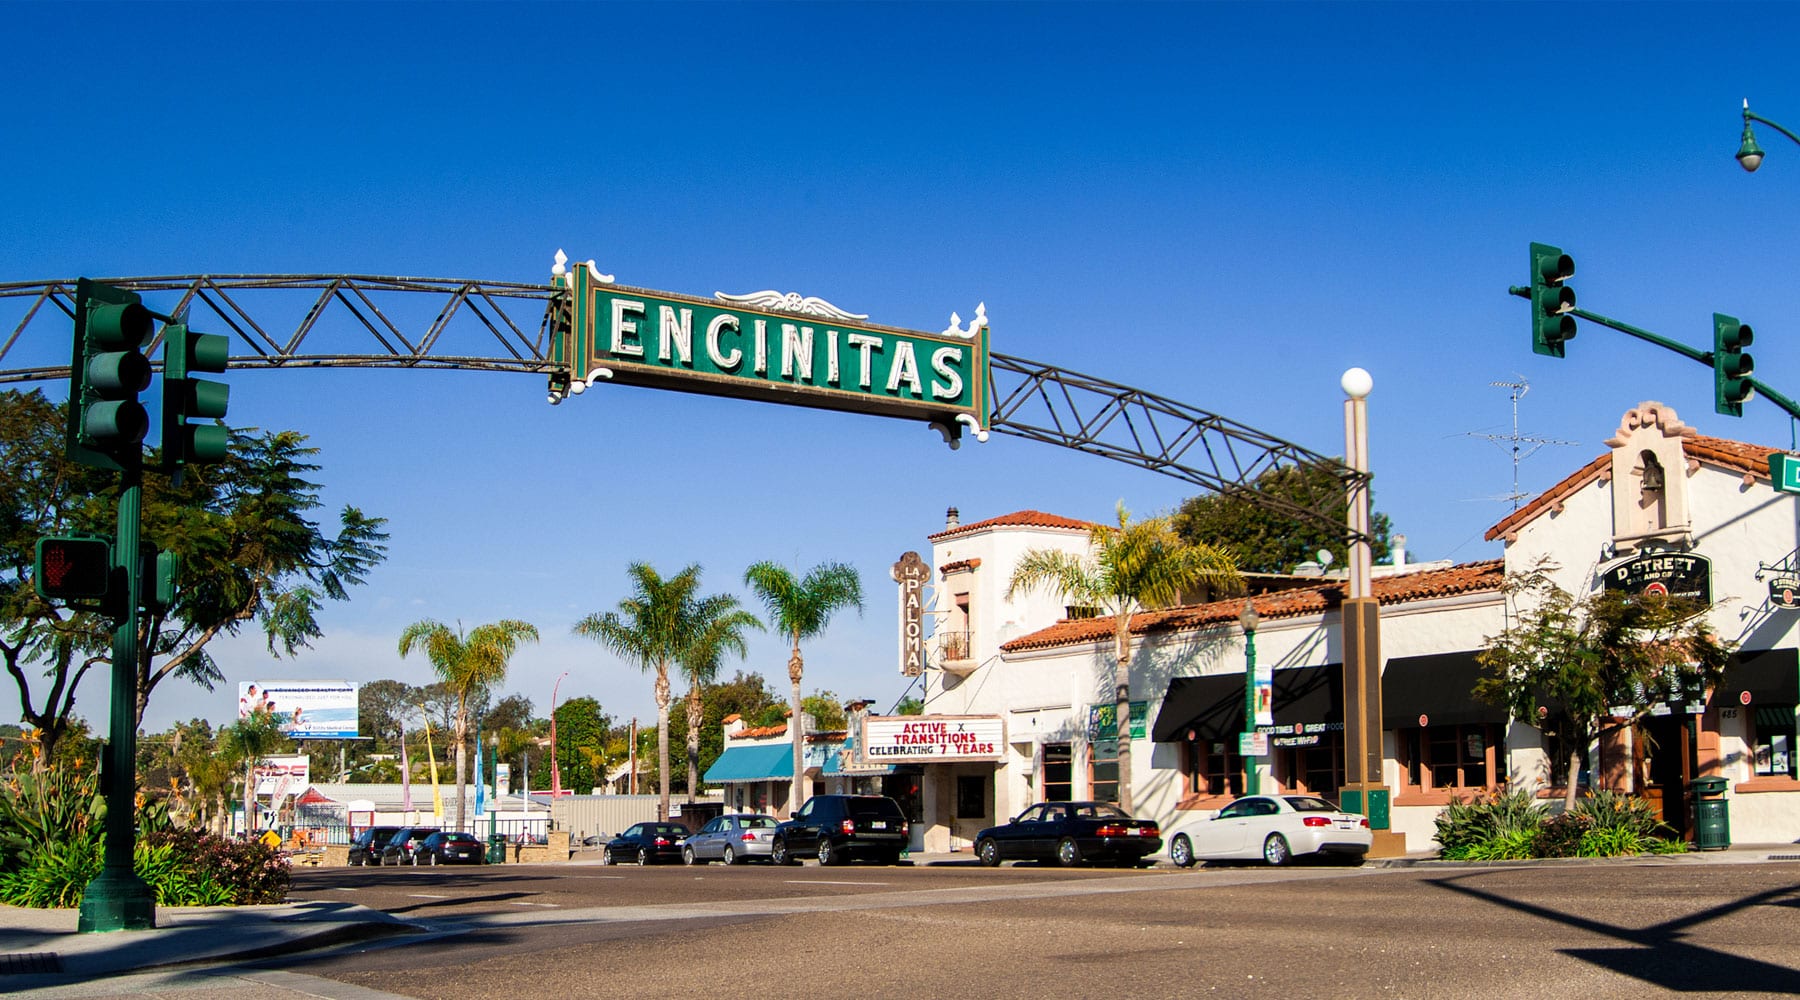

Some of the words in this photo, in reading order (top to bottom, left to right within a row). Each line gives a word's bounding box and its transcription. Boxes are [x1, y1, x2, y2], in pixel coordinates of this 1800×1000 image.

[609, 298, 964, 399] ENCINITAS
[905, 566, 920, 576] LA
[1616, 567, 1628, 580] D
[1631, 557, 1696, 575] STREET
[1643, 572, 1660, 581] AND
[906, 579, 920, 666] PALOMA
[903, 722, 947, 734] ACTIVE
[957, 722, 965, 732] X
[1257, 727, 1275, 735] GOOD
[1275, 725, 1294, 734] TIMES
[1304, 723, 1326, 733] GREAT
[894, 732, 976, 745] TRANSITIONS
[869, 745, 934, 756] CELEBRATING
[940, 744, 947, 755] 7
[955, 743, 994, 754] YEARS
